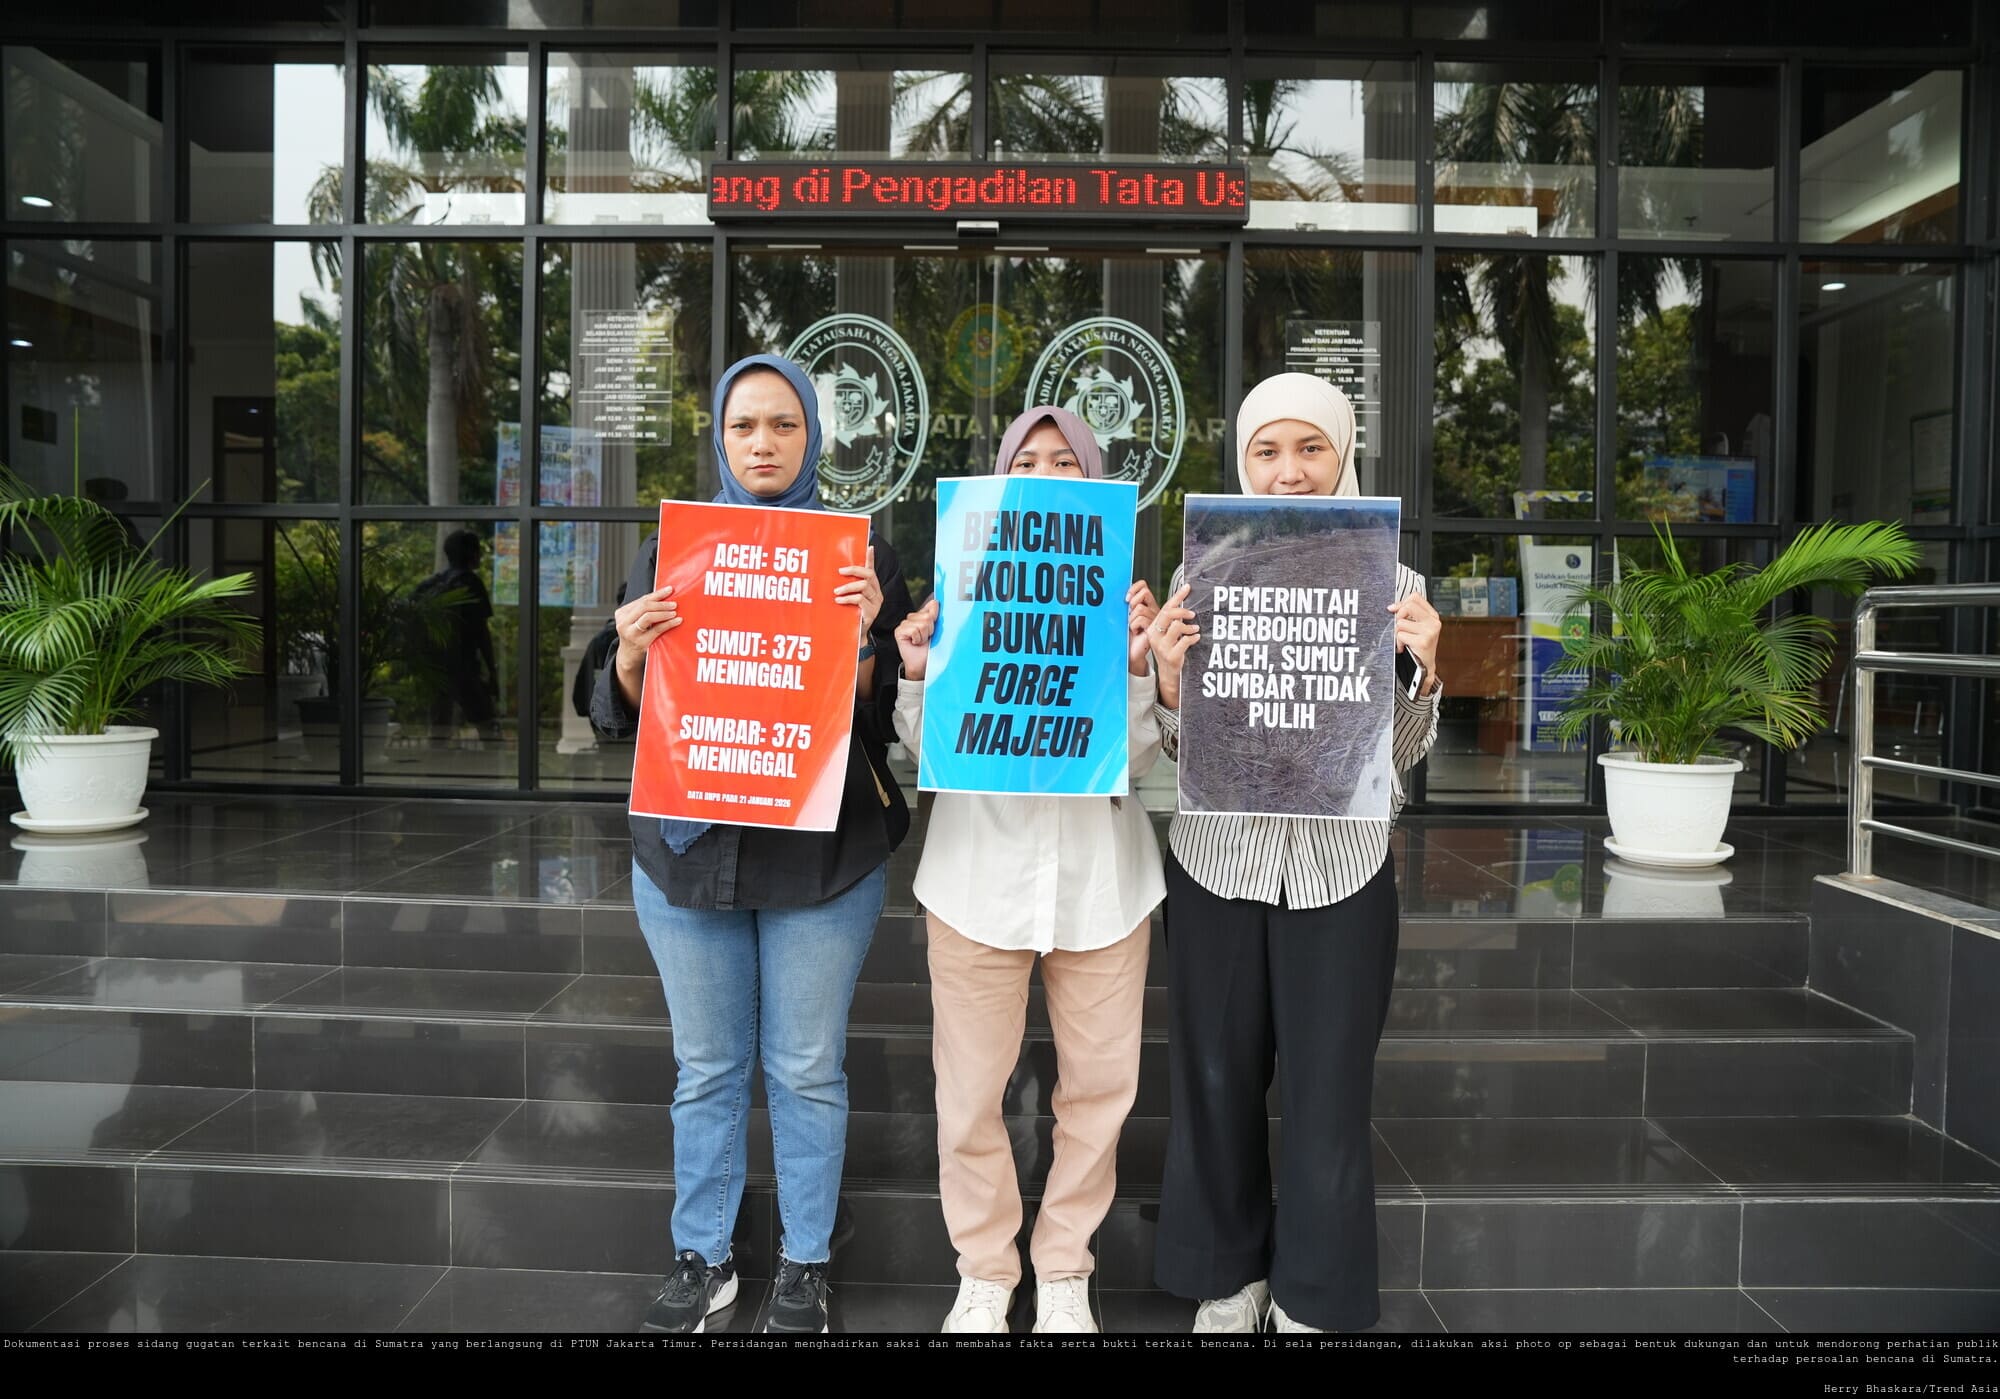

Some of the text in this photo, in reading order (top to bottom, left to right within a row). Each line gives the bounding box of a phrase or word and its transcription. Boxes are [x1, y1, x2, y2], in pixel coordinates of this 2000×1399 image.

[792, 168, 830, 203] di
[841, 168, 1077, 211] Pengadilan
[1088, 170, 1184, 206] Tata
[1197, 171, 1245, 207] Us
[872, 334, 907, 378] NEGARA
[901, 380, 917, 436] JAKARTA
[1128, 337, 1162, 383] NEGARA
[1157, 383, 1173, 440] JAKARTA
[962, 510, 1104, 556] BENCANA
[713, 543, 809, 574] ACEH: 561
[703, 571, 813, 603] MENINGGAL
[958, 561, 1105, 607] EKOLOGIS
[1213, 586, 1359, 615] PEMERINTAH
[695, 628, 812, 661] SUMUT: 375
[982, 611, 1086, 656] BUKAN
[1212, 614, 1357, 644] BERBOHONG!
[696, 658, 805, 690] MENINGGAL
[1208, 643, 1366, 676] ACEH, SUMUT,
[974, 662, 1079, 707] FORCE
[1202, 672, 1372, 702] SUMBAR TIDAK
[1249, 701, 1316, 729] PULIH
[679, 714, 812, 750] SUMBAR: 375
[955, 713, 1094, 758] MAJEUR
[687, 745, 798, 778] MENINGGAL
[687, 790, 703, 800] DATA
[739, 795, 747, 804] 21
